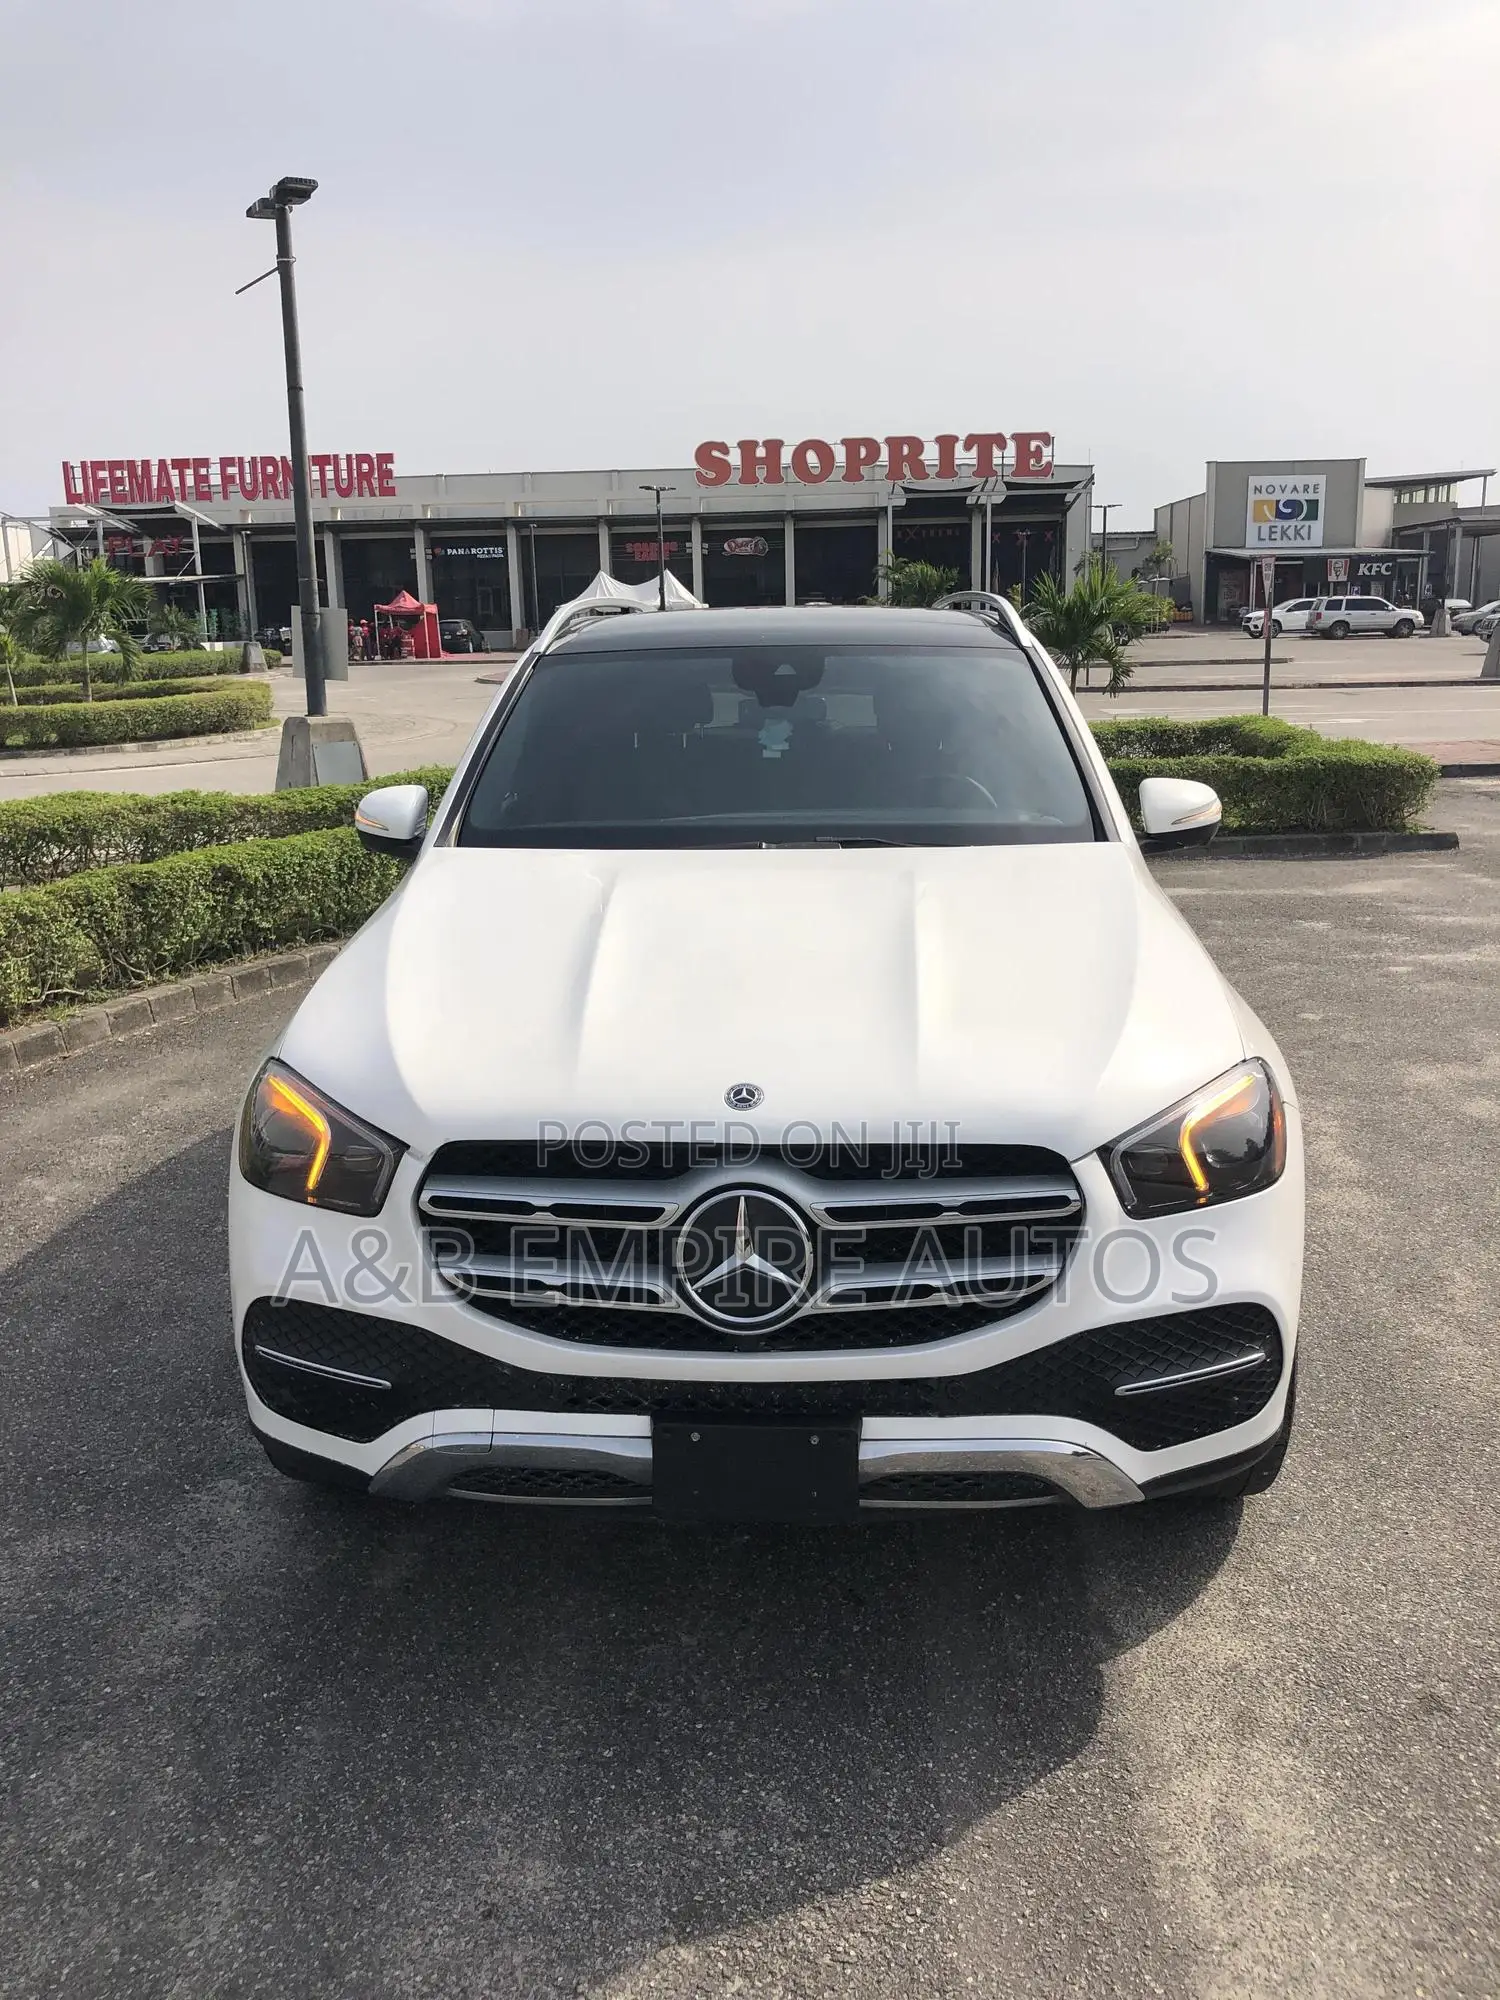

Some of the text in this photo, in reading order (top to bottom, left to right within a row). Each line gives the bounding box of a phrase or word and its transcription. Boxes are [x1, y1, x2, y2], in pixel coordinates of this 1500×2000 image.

[694, 432, 1053, 487] SHOPRITE
[62, 457, 211, 504] LIFEMATE
[1253, 483, 1320, 495] NOVARE
[1257, 525, 1312, 541] LEKKI
[1357, 562, 1393, 576] KFC
